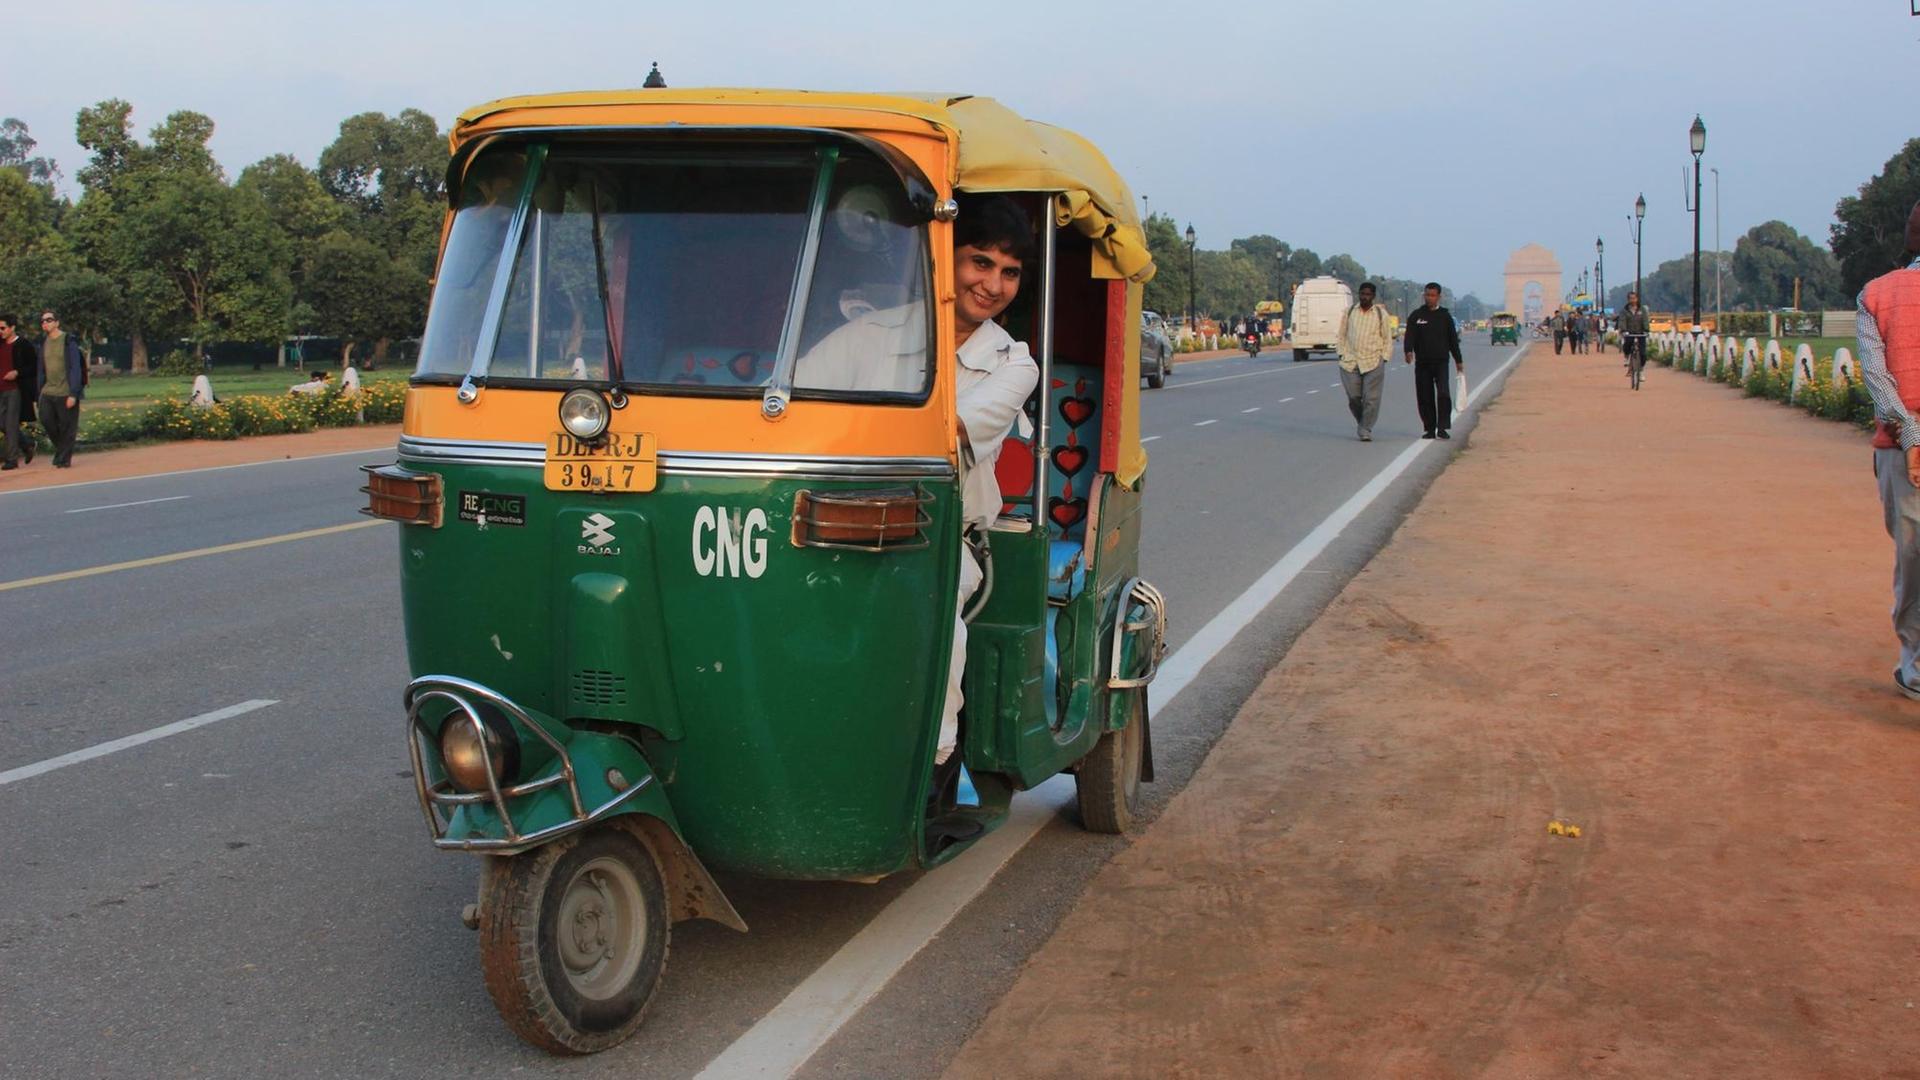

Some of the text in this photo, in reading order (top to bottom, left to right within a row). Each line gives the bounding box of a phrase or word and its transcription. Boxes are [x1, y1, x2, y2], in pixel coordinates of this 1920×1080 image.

[562, 464, 635, 488] 3917
[464, 494, 520, 513] RE CNG
[577, 545, 621, 555] BAJAJ
[692, 505, 768, 578] CNG
